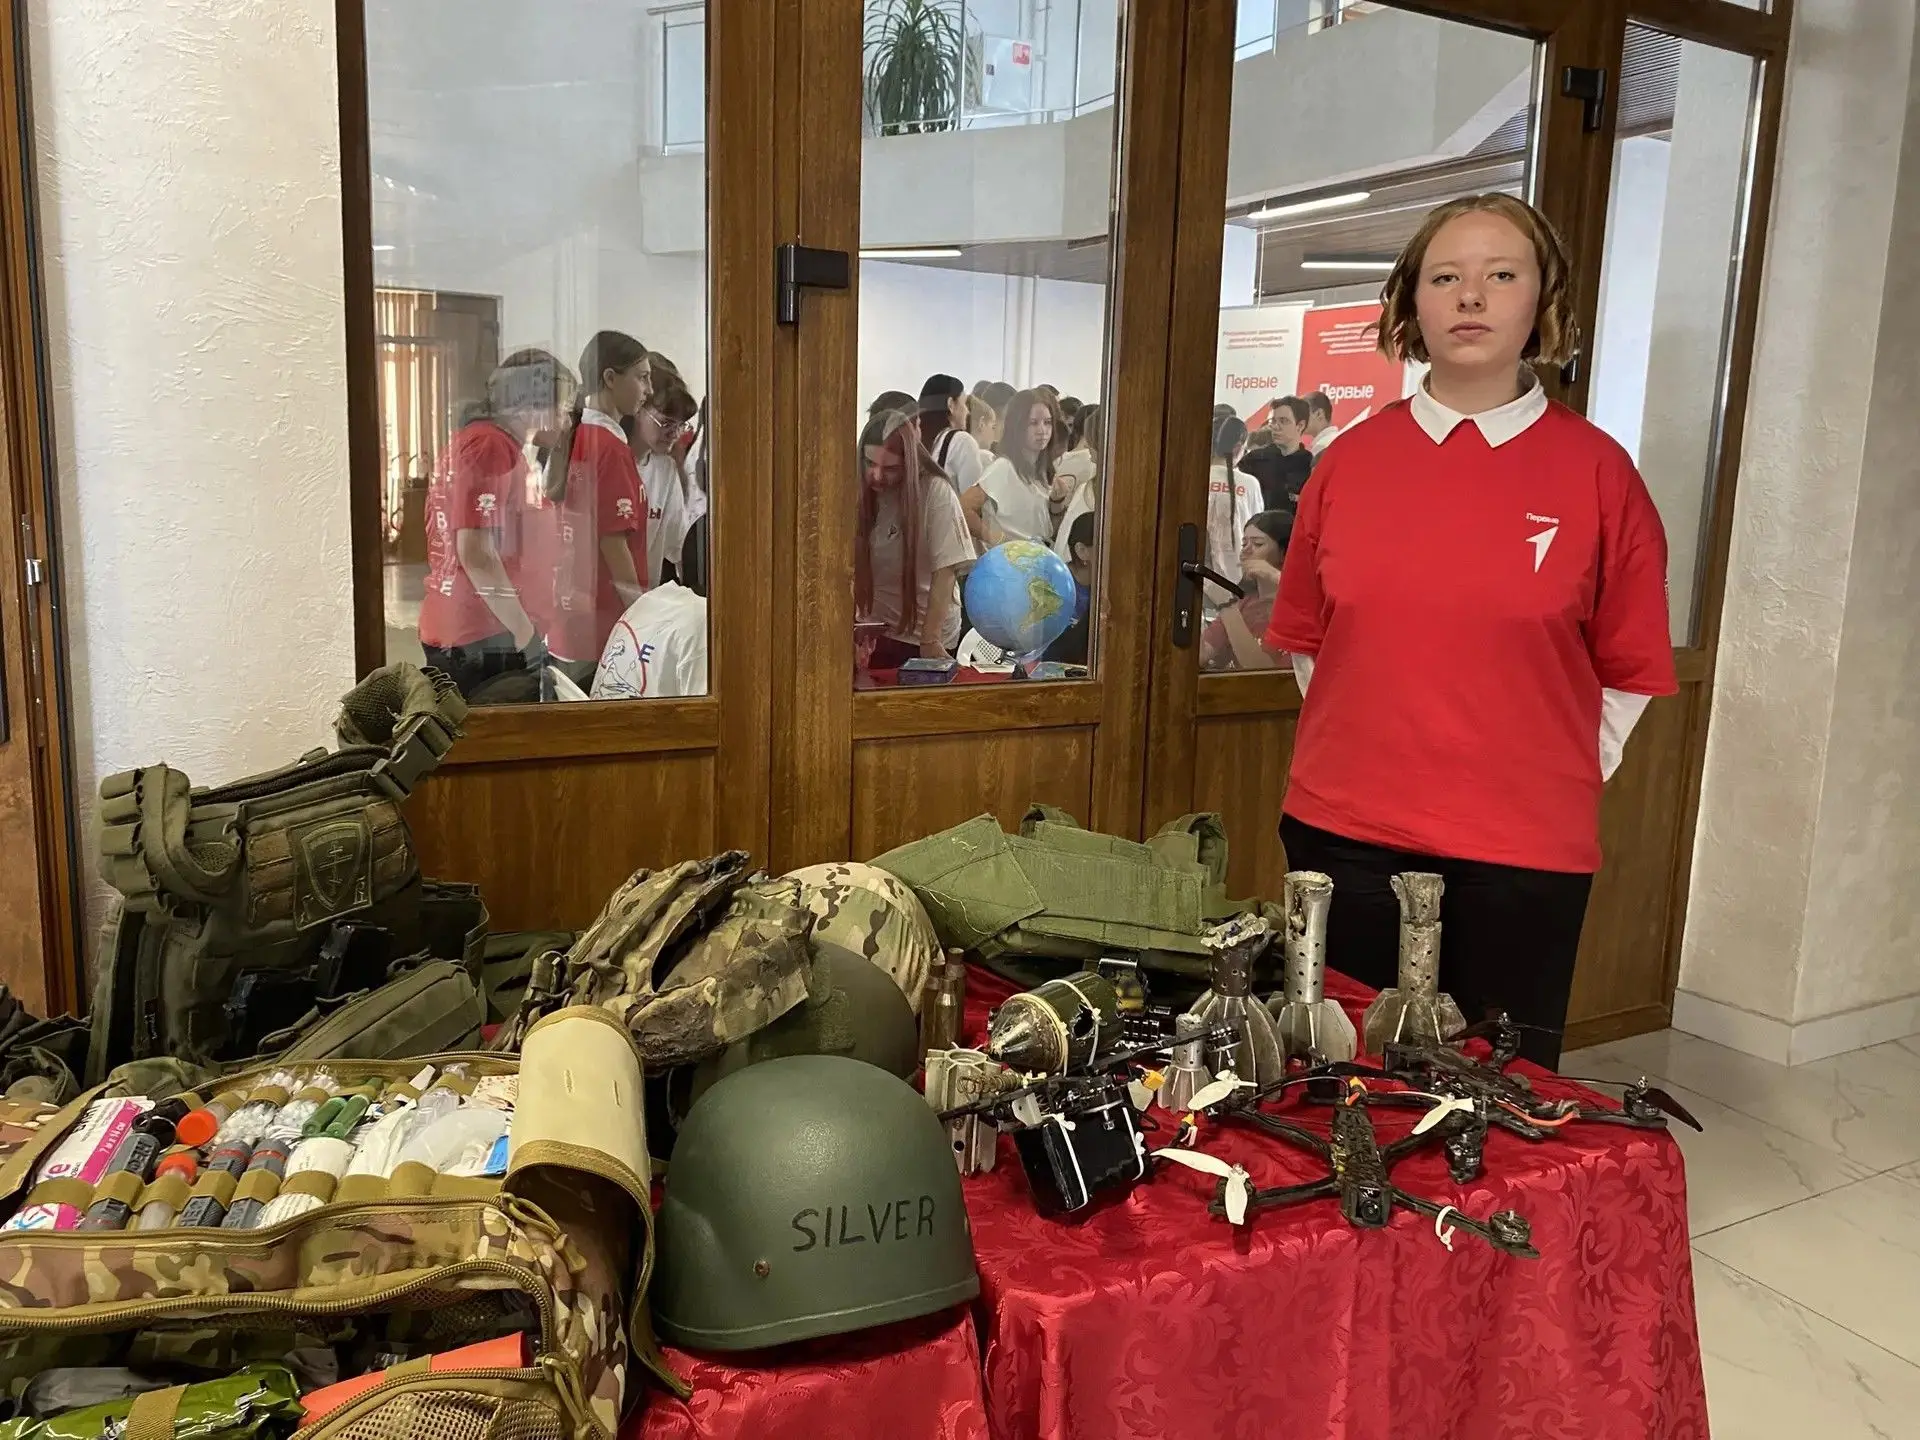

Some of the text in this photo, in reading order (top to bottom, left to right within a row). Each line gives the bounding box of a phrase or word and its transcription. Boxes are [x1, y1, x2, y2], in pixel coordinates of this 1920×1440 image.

[1226, 374, 1278, 394] Первые
[1319, 383, 1375, 405] Первые
[791, 1195, 935, 1252] SILVER
